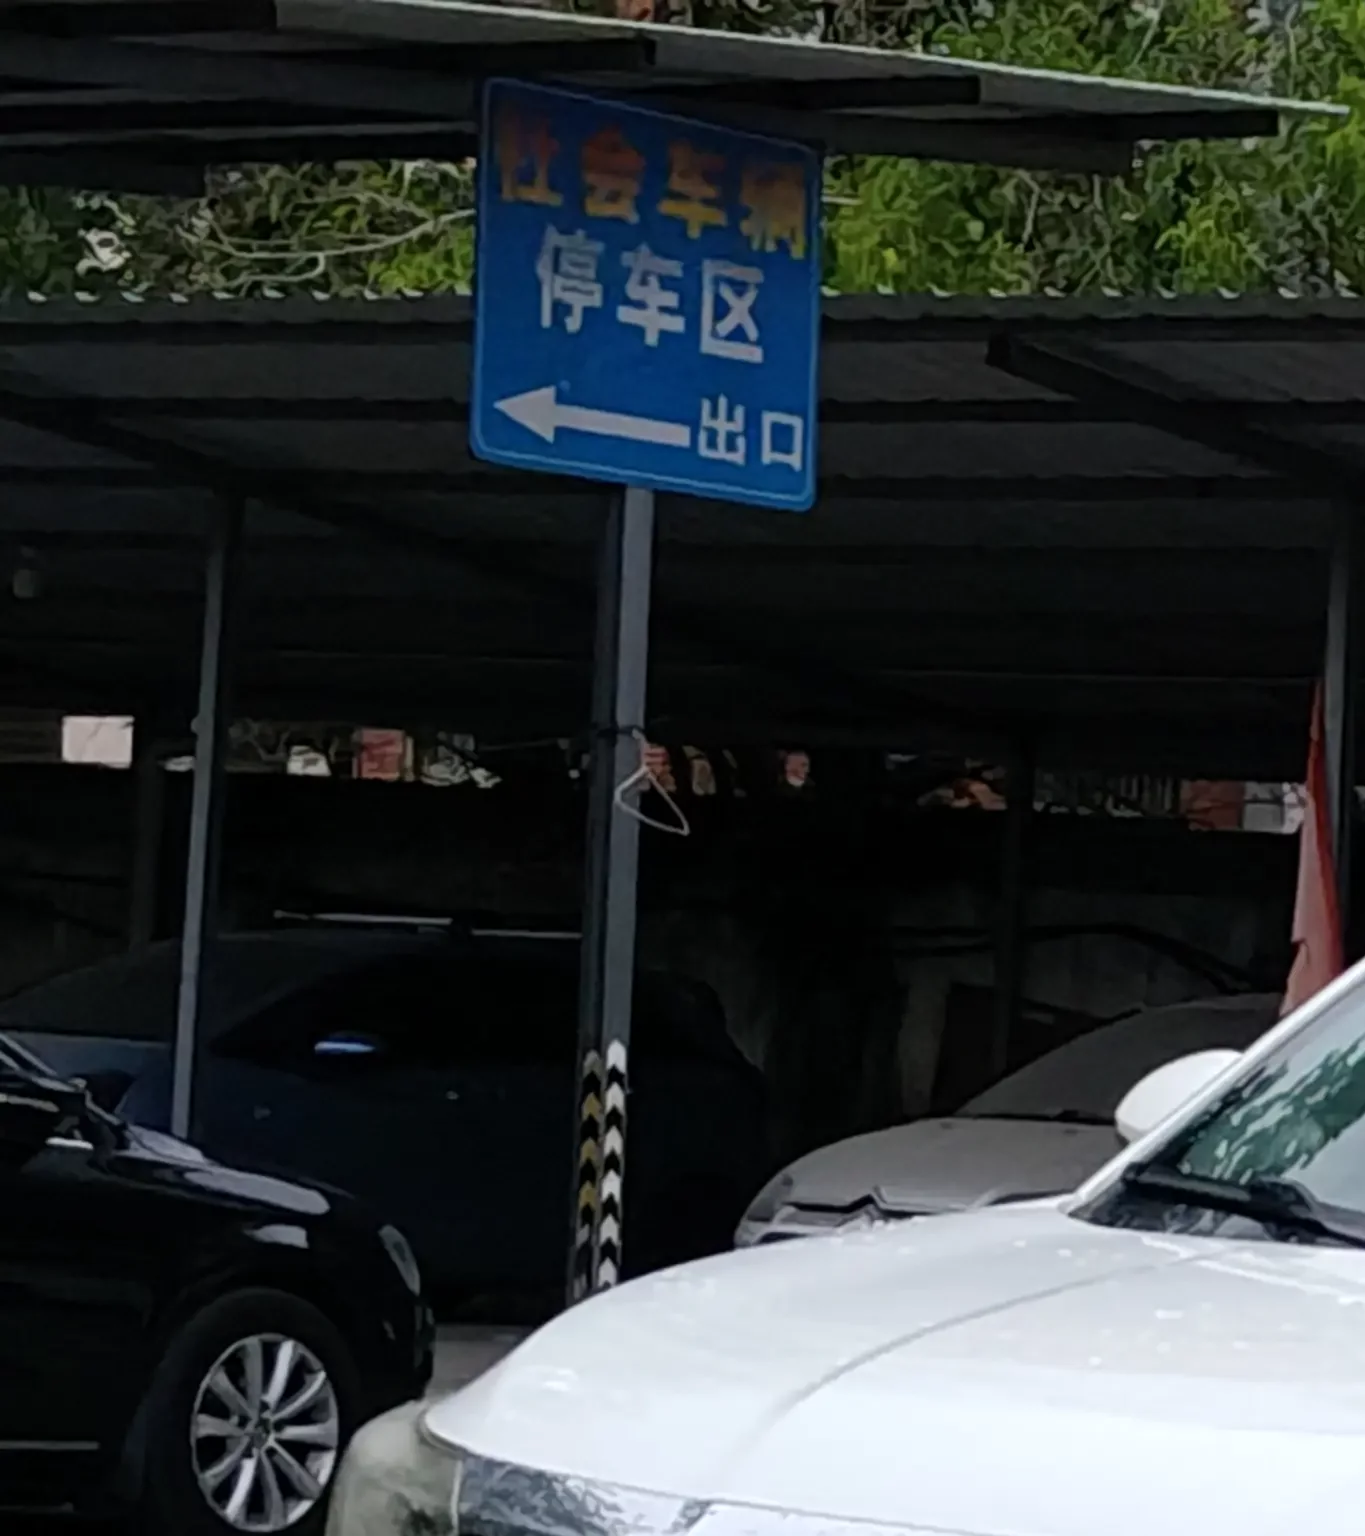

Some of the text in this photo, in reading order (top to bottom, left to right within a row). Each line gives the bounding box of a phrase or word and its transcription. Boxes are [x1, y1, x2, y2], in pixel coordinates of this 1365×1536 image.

[495, 107, 806, 259] 社会车辆
[536, 224, 764, 364] 停车区
[698, 393, 804, 472] 出口
